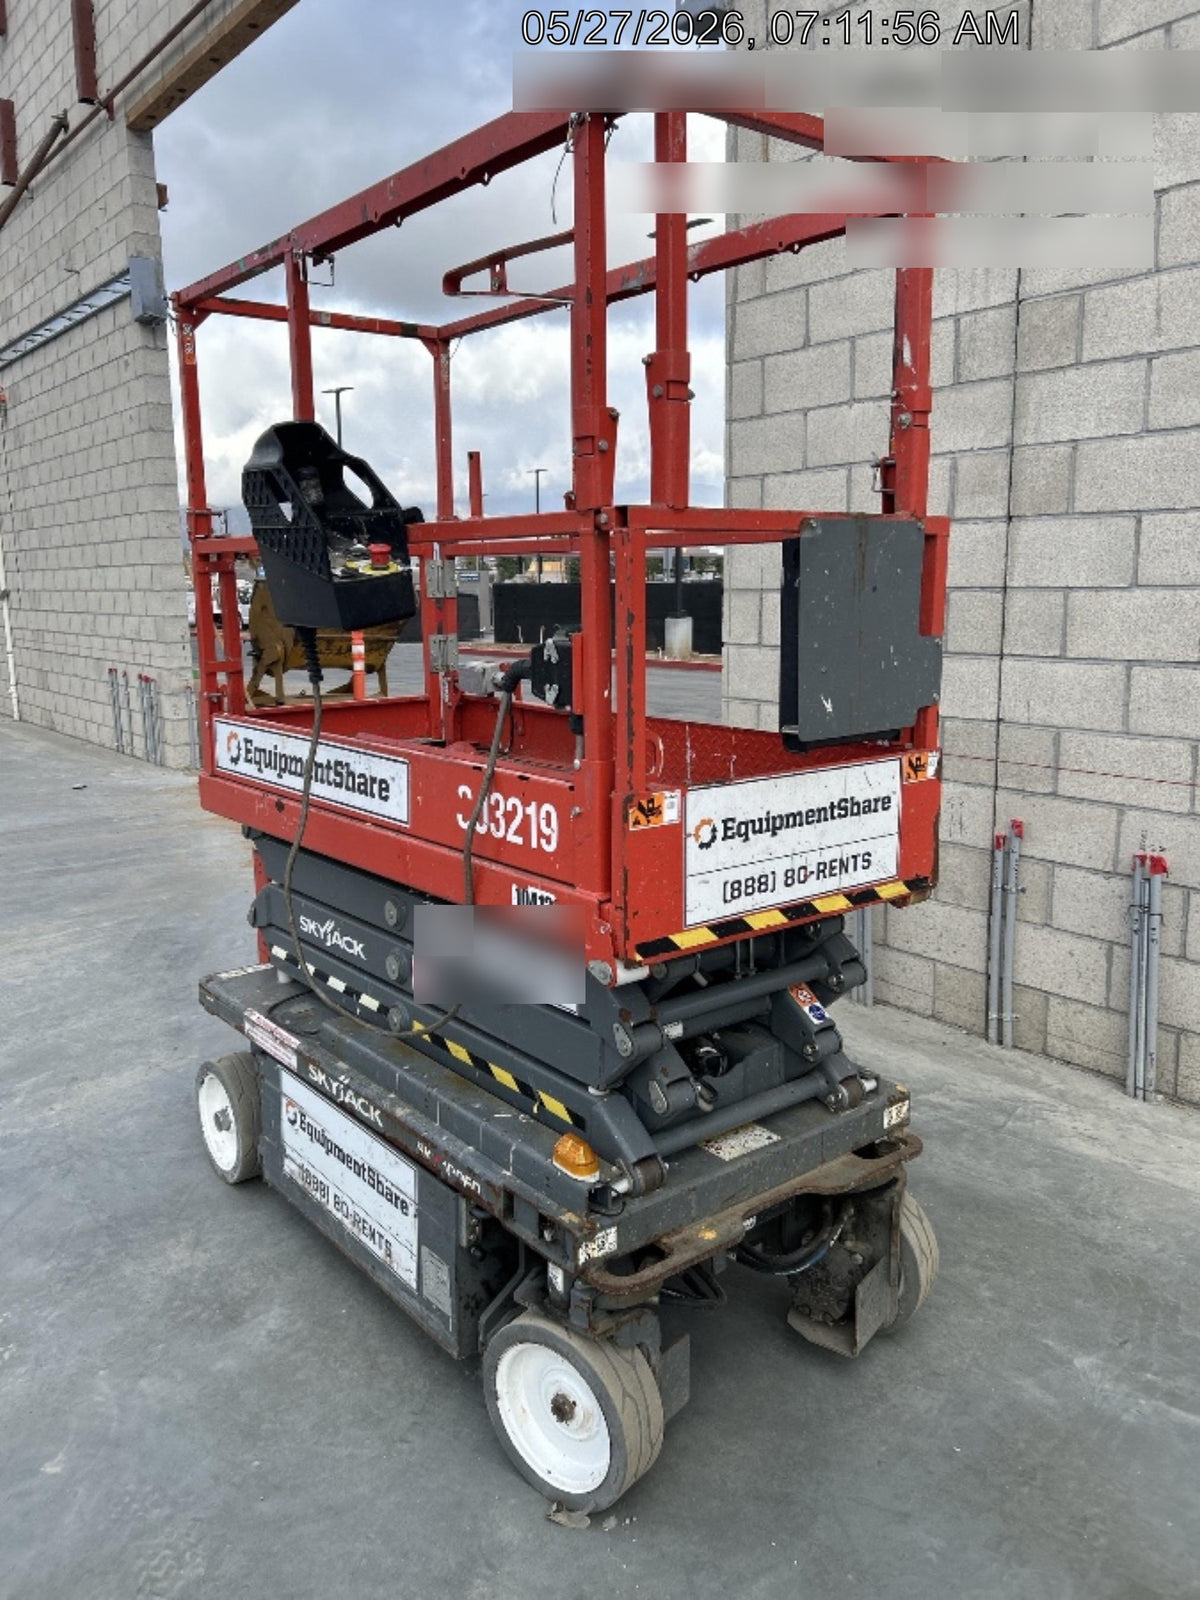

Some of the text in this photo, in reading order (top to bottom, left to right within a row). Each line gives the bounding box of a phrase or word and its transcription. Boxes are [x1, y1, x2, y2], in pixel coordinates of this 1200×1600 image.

[243, 737, 390, 802] EquipmntShare
[721, 794, 892, 843] EquipmentShare
[784, 852, 872, 888] 80-RENTS
[300, 915, 367, 961] SKYJACK
[308, 1064, 383, 1128] SKYJACK
[299, 1111, 410, 1217] EquipmentShare
